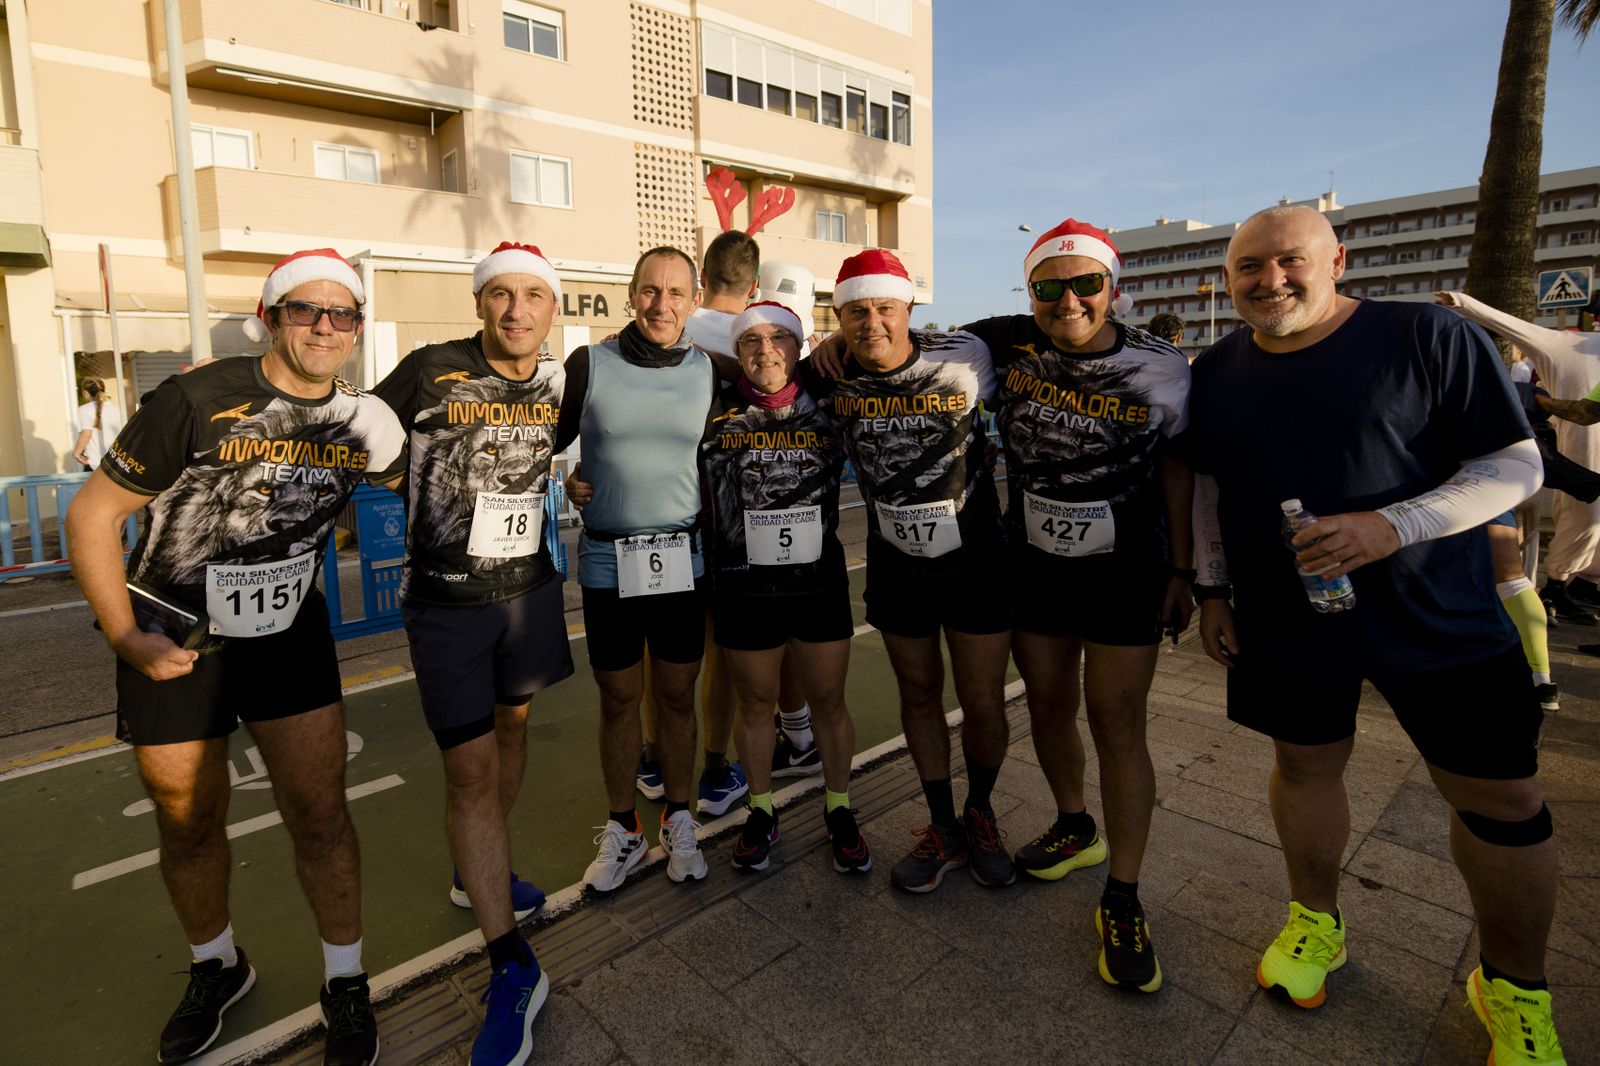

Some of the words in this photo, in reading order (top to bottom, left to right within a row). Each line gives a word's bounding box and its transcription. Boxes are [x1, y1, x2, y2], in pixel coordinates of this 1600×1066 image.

[558, 293, 609, 317] LFA
[834, 392, 967, 418] INMOVALOR.ES
[1005, 368, 1150, 424] INMOVALOR.ES
[859, 415, 927, 433] TEAM
[1026, 400, 1096, 434] TEAM
[483, 425, 542, 442] TEAM
[218, 437, 369, 470] INMOVALOR.ES
[749, 449, 807, 462] TEAM
[259, 462, 333, 485] TEAM
[482, 501, 516, 511] CIUDAD
[517, 503, 526, 511] DE
[484, 495, 505, 503] SAN
[1048, 504, 1107, 512] SILVESTRE
[769, 510, 817, 520] SILVESTRE
[896, 505, 949, 515] SILVESTRE
[1029, 503, 1060, 517] CIUDAD
[1063, 511, 1075, 519] DE
[503, 513, 528, 536] 18
[750, 519, 781, 527] CIUDAD
[893, 521, 937, 542] 817
[1040, 517, 1092, 542] 427
[622, 543, 650, 553] CIUDAD
[779, 527, 793, 548] 5
[216, 571, 246, 579] SAN
[249, 558, 311, 577] SILVESTRE
[649, 552, 663, 574] 6
[216, 576, 265, 588] CIUDAD
[267, 575, 282, 583] DE
[225, 577, 302, 616] 1151
